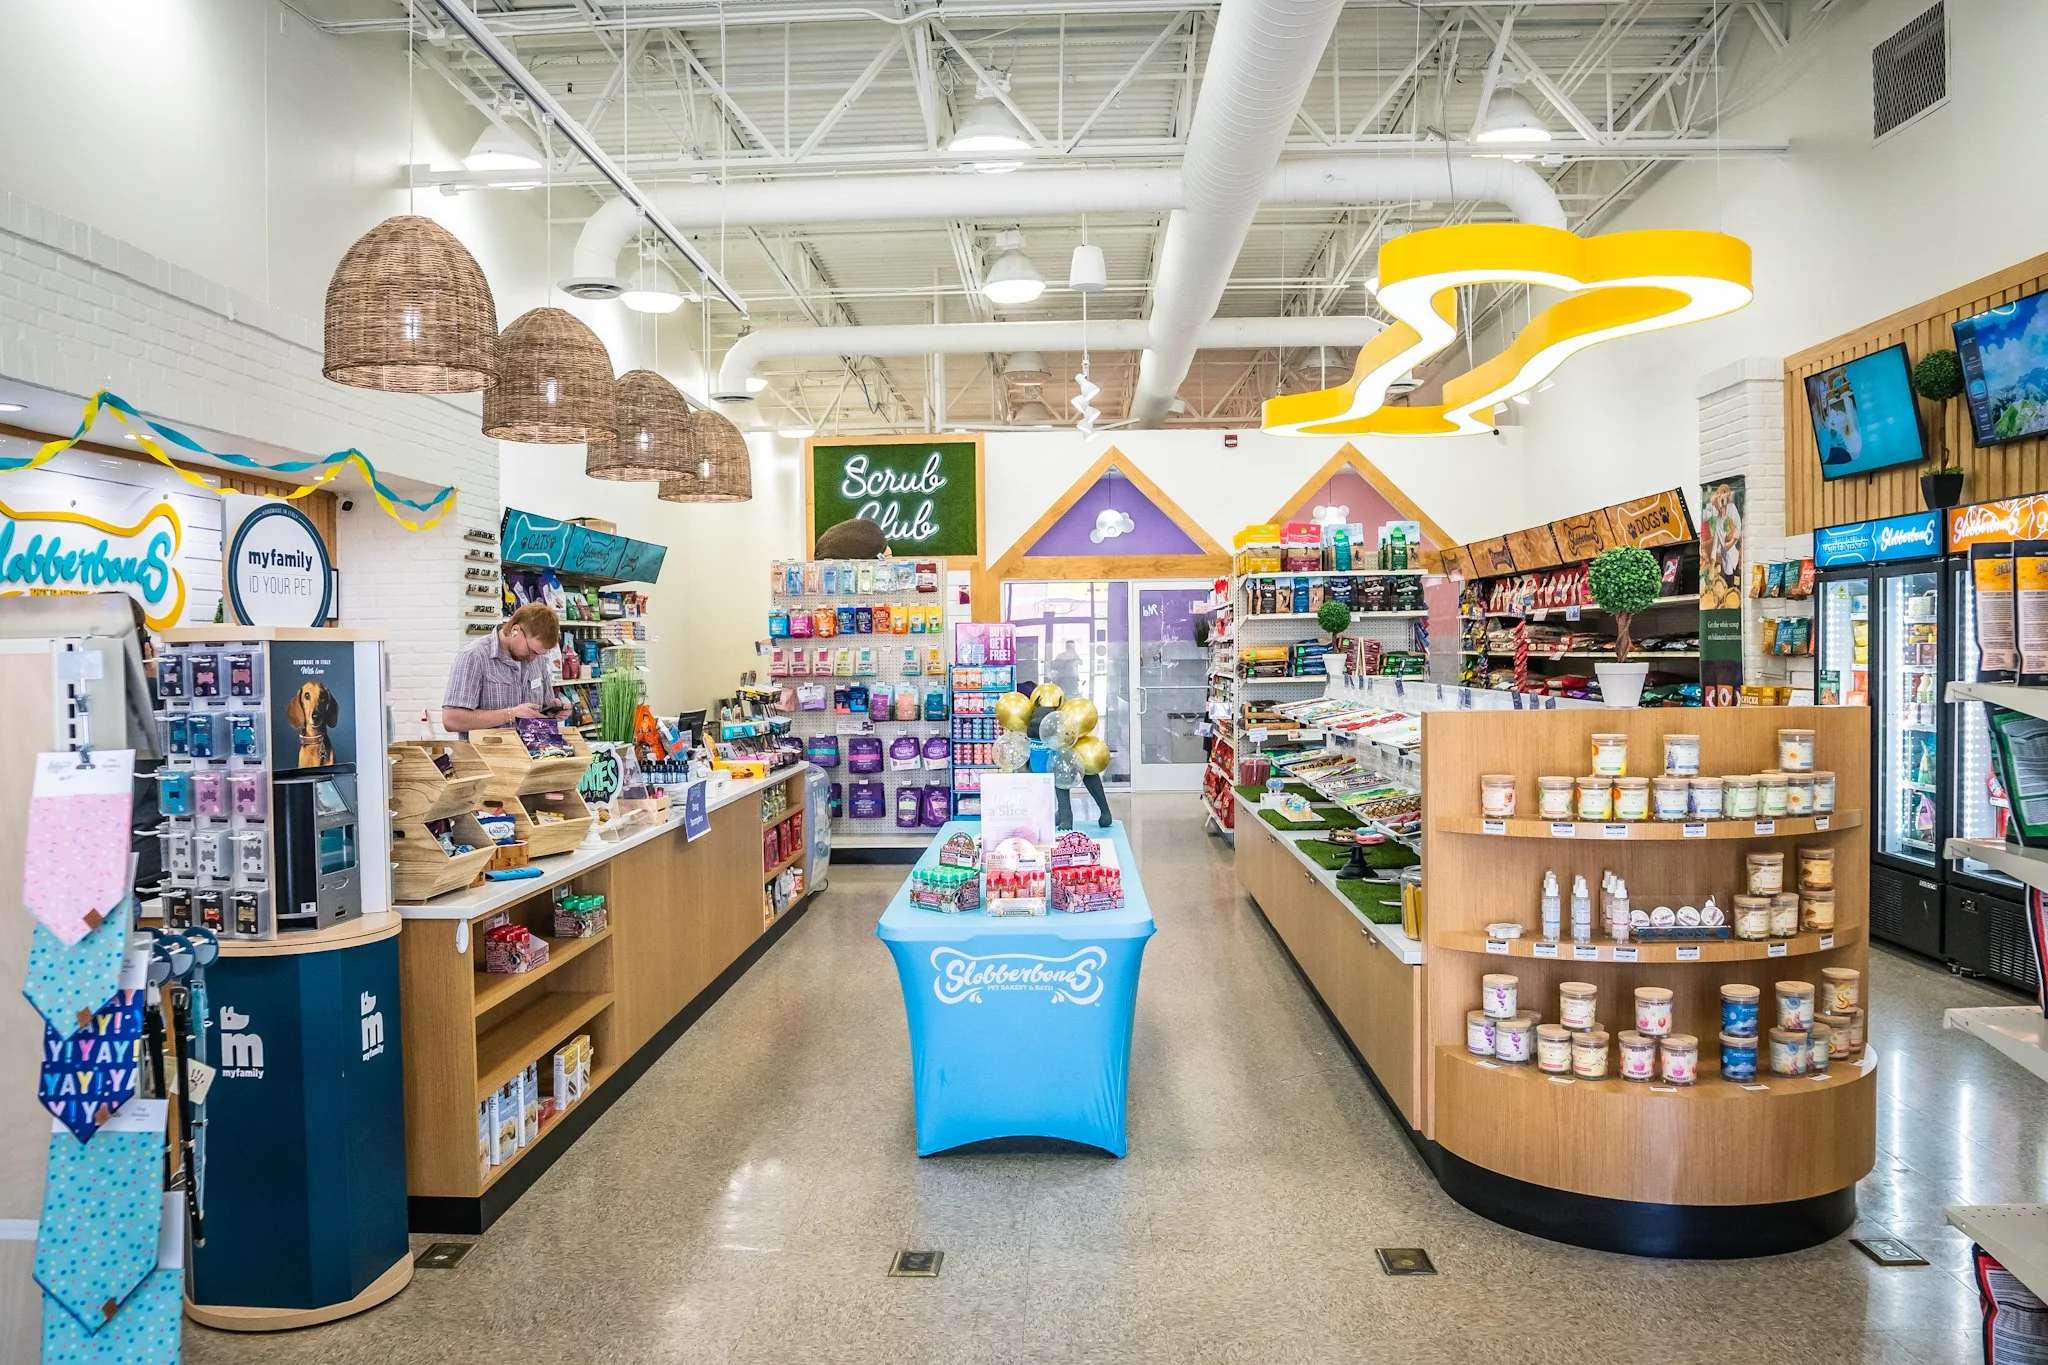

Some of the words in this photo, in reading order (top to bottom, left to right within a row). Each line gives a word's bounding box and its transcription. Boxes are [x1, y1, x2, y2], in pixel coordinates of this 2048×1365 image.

[841, 451, 948, 498] Scrub
[855, 500, 940, 542] Club
[1636, 511, 1661, 534] DOGS
[527, 534, 551, 550] CATS
[248, 549, 313, 572] myfamily
[481, 568, 491, 577] CLUB
[249, 576, 259, 593] ID
[263, 576, 291, 595] YOUR
[294, 578, 313, 595] PET
[474, 605, 495, 613] UPGRADES
[989, 627, 1004, 638] BUY
[1006, 626, 1011, 638] 3
[989, 638, 1005, 649] GET
[1007, 638, 1011, 649] 1
[989, 649, 1011, 661] FREE!
[999, 805, 1028, 816] Slice
[362, 1044, 384, 1062] myfamily
[222, 1068, 264, 1079] myfamily
